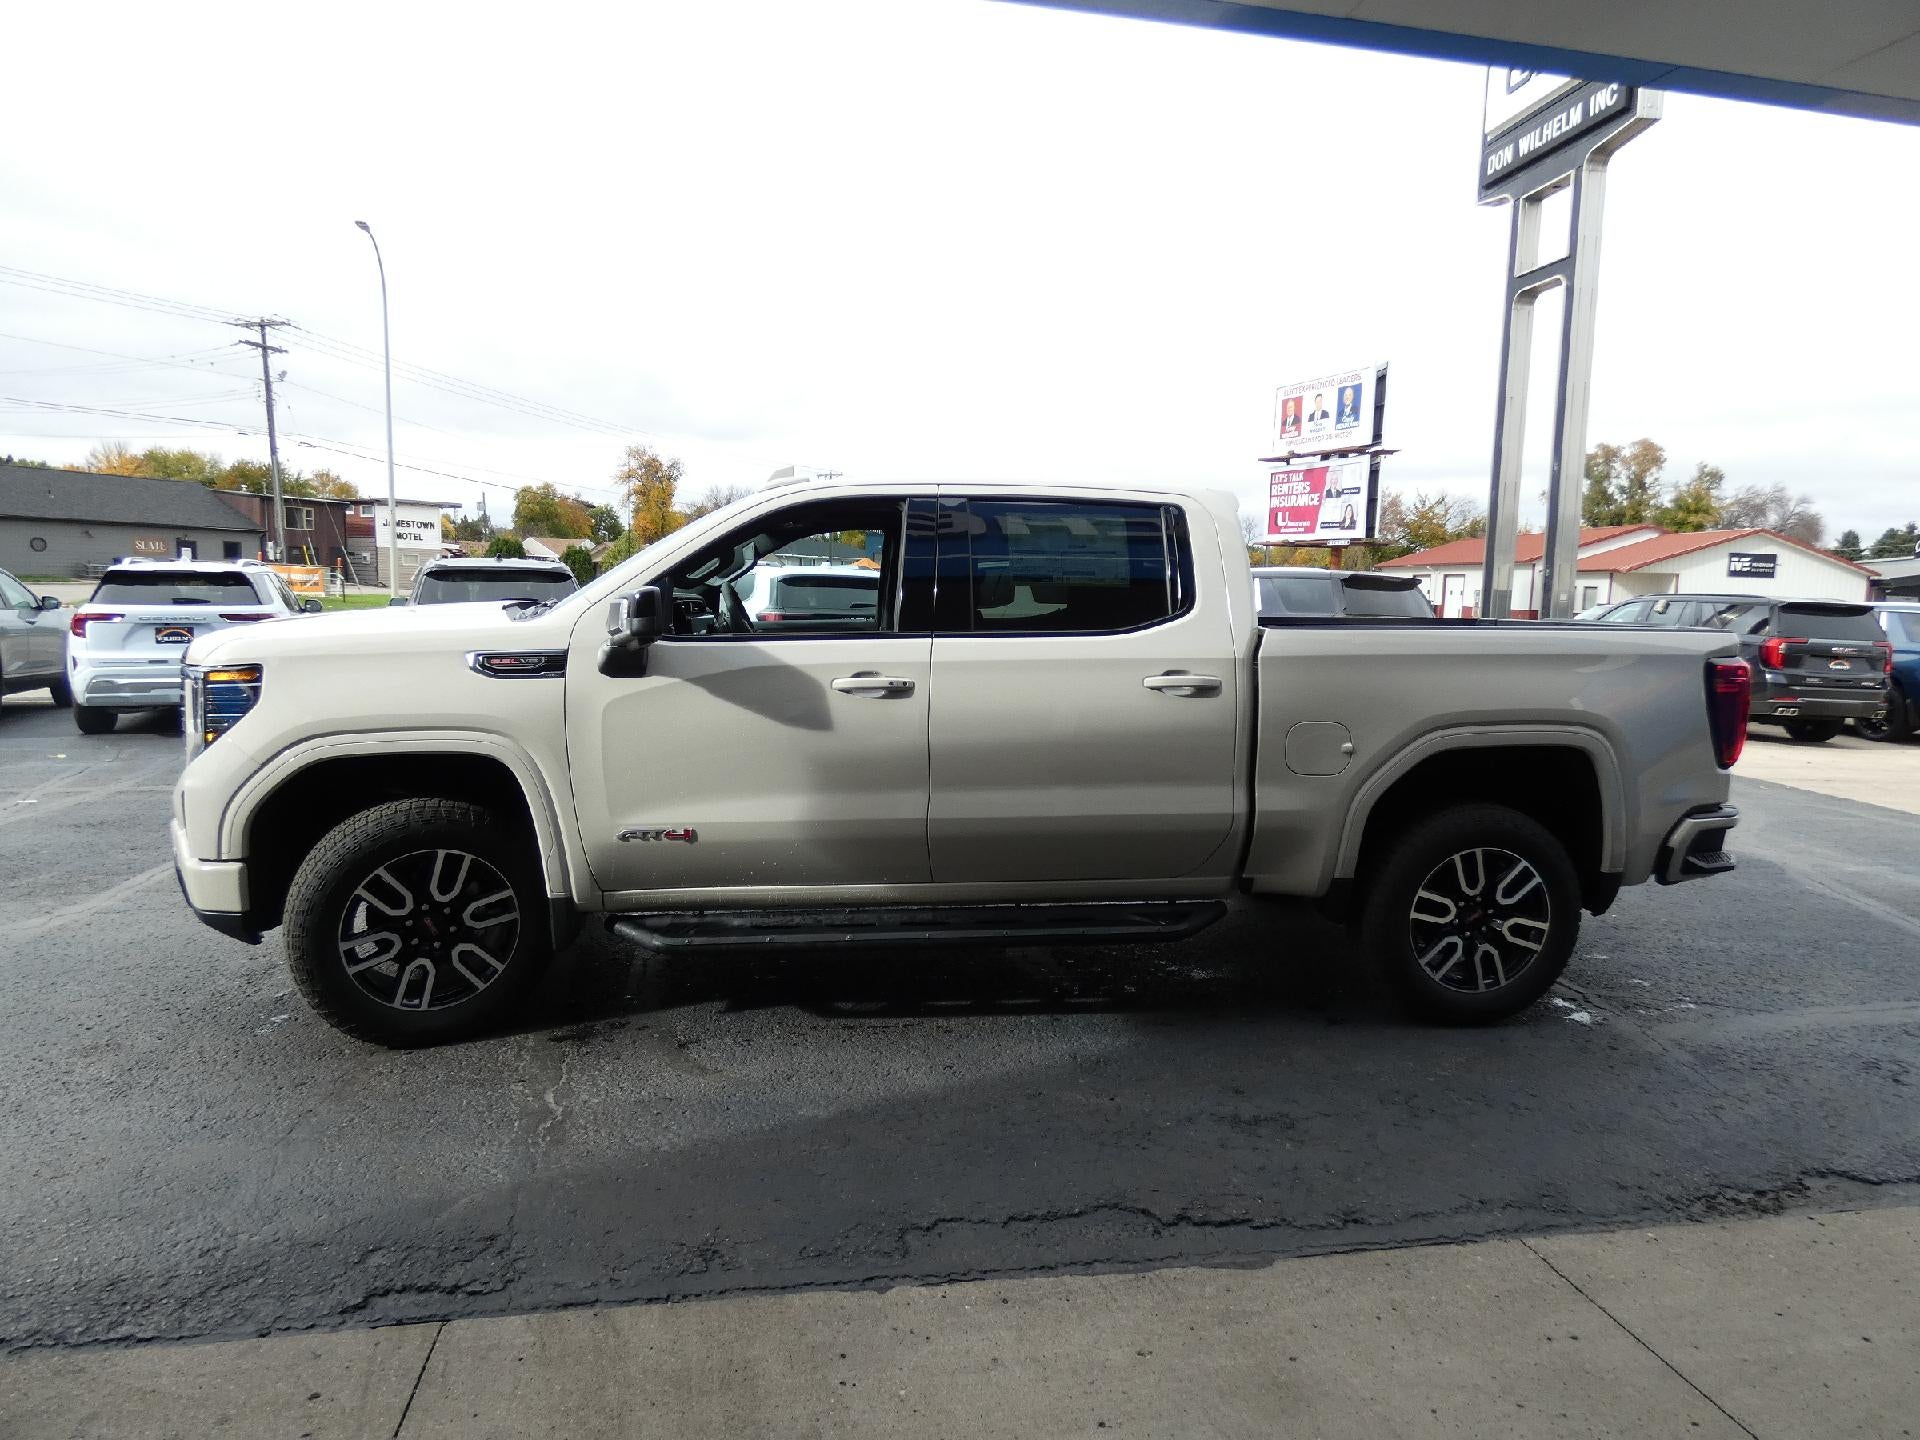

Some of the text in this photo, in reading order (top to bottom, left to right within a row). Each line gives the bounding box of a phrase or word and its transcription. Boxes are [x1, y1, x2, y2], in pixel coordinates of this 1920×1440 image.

[1487, 82, 1619, 176] DON WILHELM INC
[1271, 471, 1304, 484] LET'S TALK
[1271, 481, 1311, 496] RENTERS
[1270, 493, 1320, 508] INSURANCE
[382, 519, 435, 529] JMESTOWN
[396, 532, 423, 541] MOTEL
